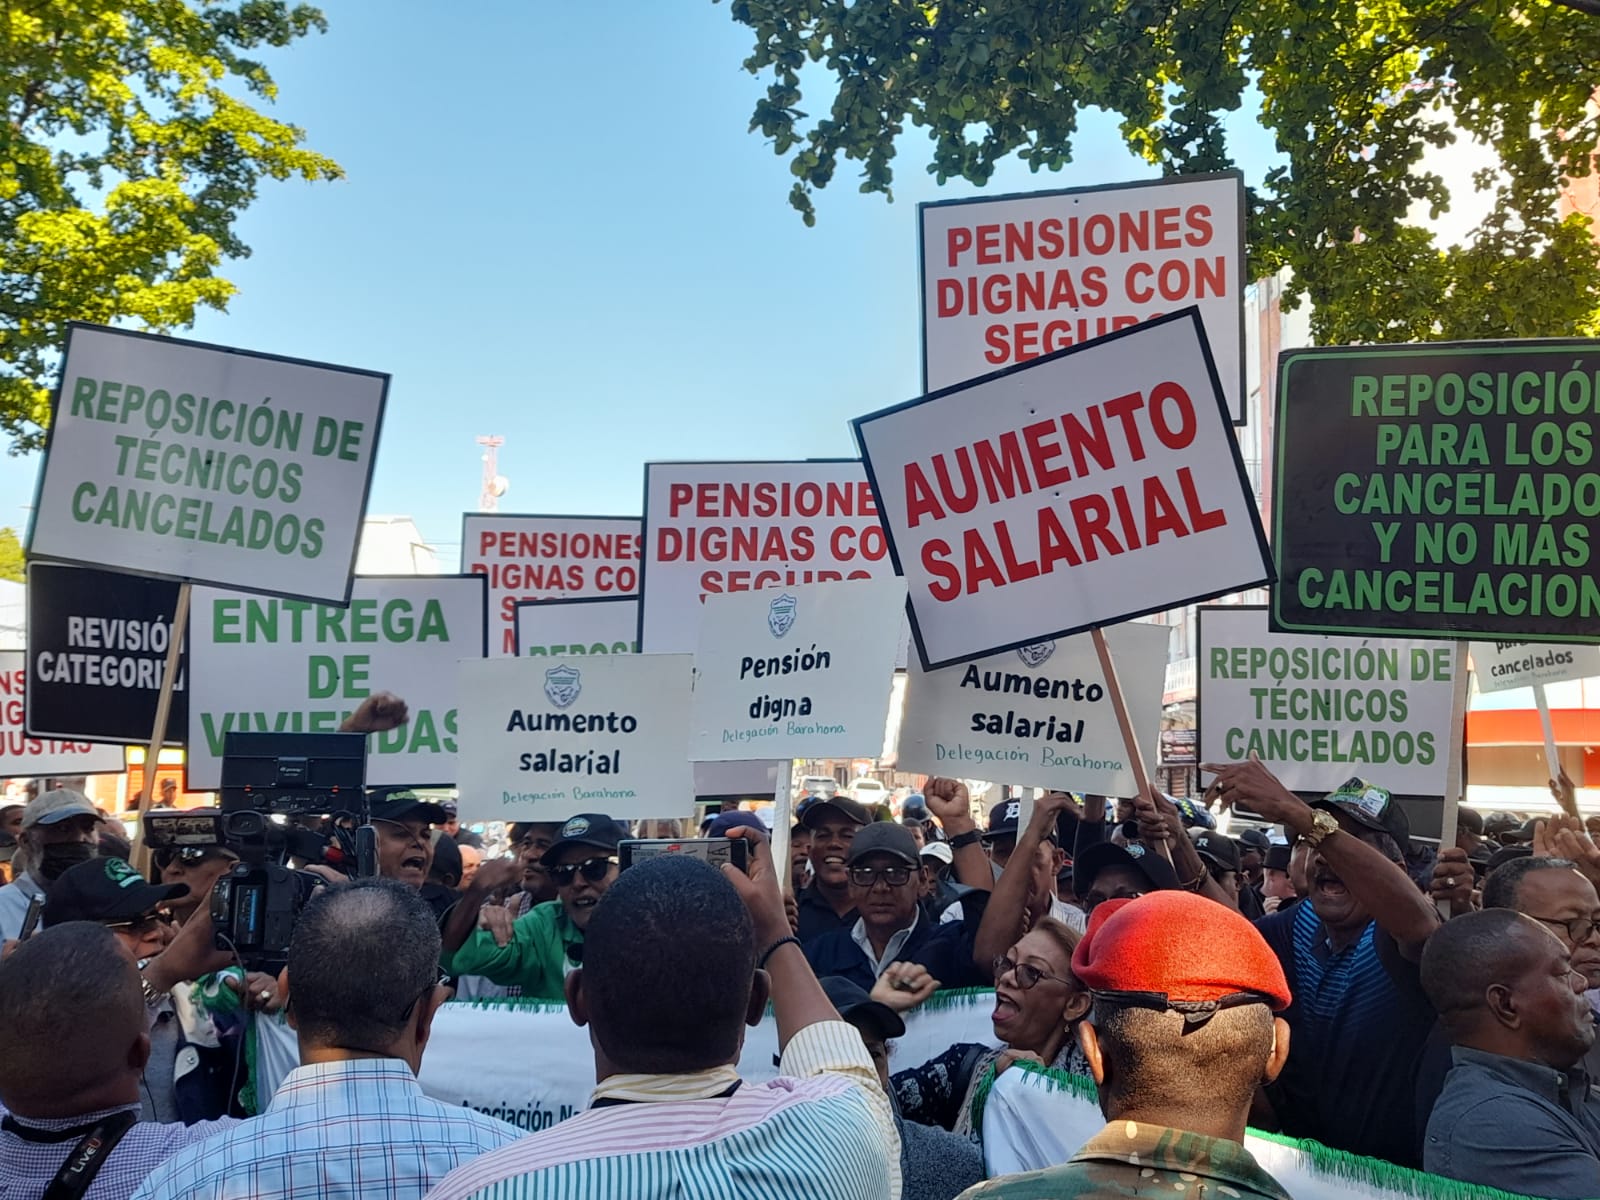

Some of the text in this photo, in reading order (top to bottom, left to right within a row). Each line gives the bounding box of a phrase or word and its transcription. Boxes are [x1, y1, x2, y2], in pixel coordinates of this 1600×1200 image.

[947, 204, 1213, 268] PENSIONES
[937, 256, 1226, 318] DIGNAS CON
[1352, 359, 1600, 417] REPOSICIÓ
[70, 376, 365, 462] REPOSICIÓN DE
[903, 381, 1197, 529] AUMENTO
[1376, 421, 1593, 466] PARA LOS
[114, 432, 304, 503] TÉCNICOS
[668, 481, 880, 518] PENSIONE
[1333, 471, 1600, 518] CANCELADO
[71, 481, 325, 559] CANCELADOS
[920, 467, 1228, 602] SALARIAL
[1371, 514, 1591, 568] Y NO MÁS
[656, 525, 888, 563] DIGNAS CO
[594, 565, 636, 593] CO
[1298, 567, 1600, 618] CANCELACION
[212, 598, 450, 643] ENTREGA
[36, 651, 184, 692] CATEGORI
[308, 655, 371, 699] DE
[739, 643, 831, 680] Pensión
[1210, 640, 1398, 682] REPOSICIÓN
[1409, 648, 1452, 682] DE
[1490, 649, 1574, 677] cancelados
[960, 664, 1104, 702] Aumento
[1249, 681, 1408, 723] TÉCNICOS
[507, 709, 637, 734] Aumento
[749, 695, 812, 722] digna
[970, 710, 1085, 743] salarial
[722, 721, 846, 743] Delegación Barahona
[1225, 728, 1436, 766] CANCELADOS
[518, 748, 621, 776] salarial
[935, 743, 1123, 771] Delegación Barahona
[503, 786, 637, 805] Delegación Barahona
